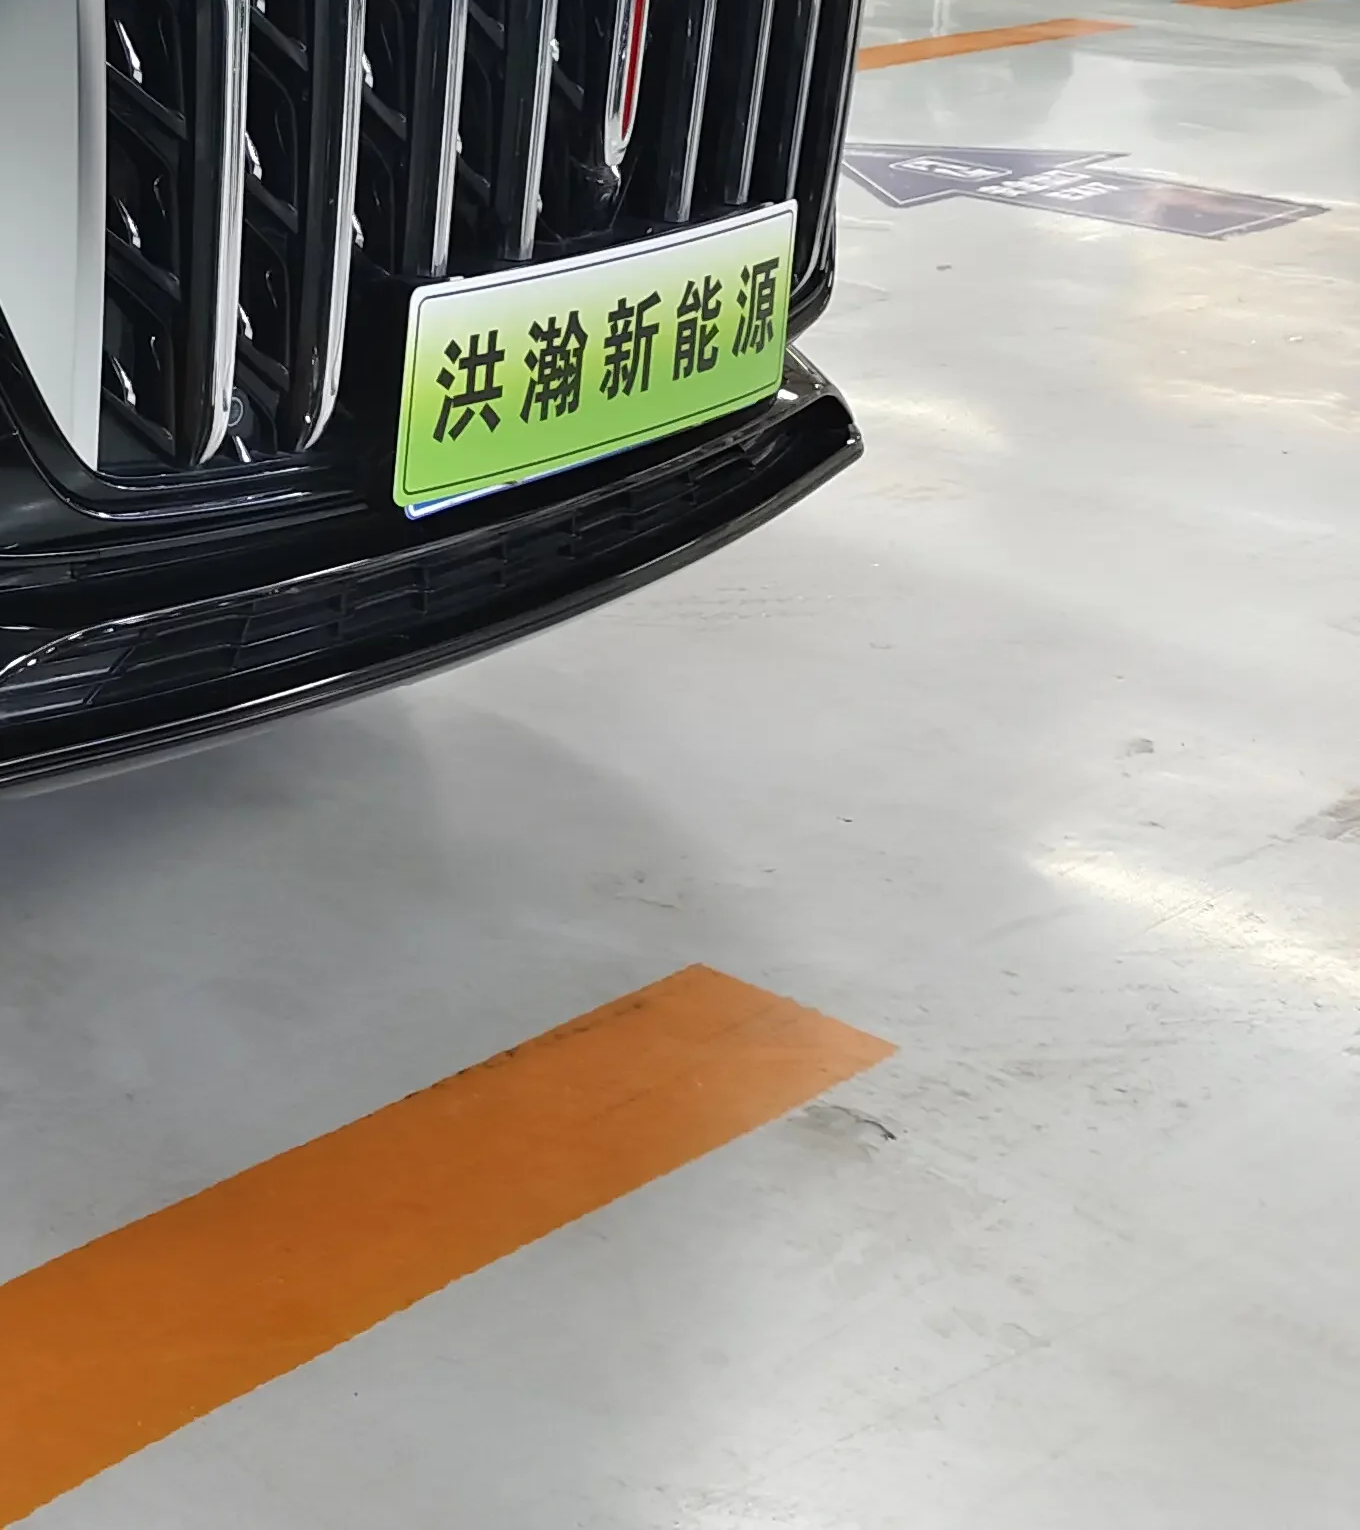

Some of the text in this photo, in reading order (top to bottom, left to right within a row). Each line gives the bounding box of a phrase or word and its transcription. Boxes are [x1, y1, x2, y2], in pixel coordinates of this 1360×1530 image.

[432, 256, 781, 444] 洪瀚新能源
